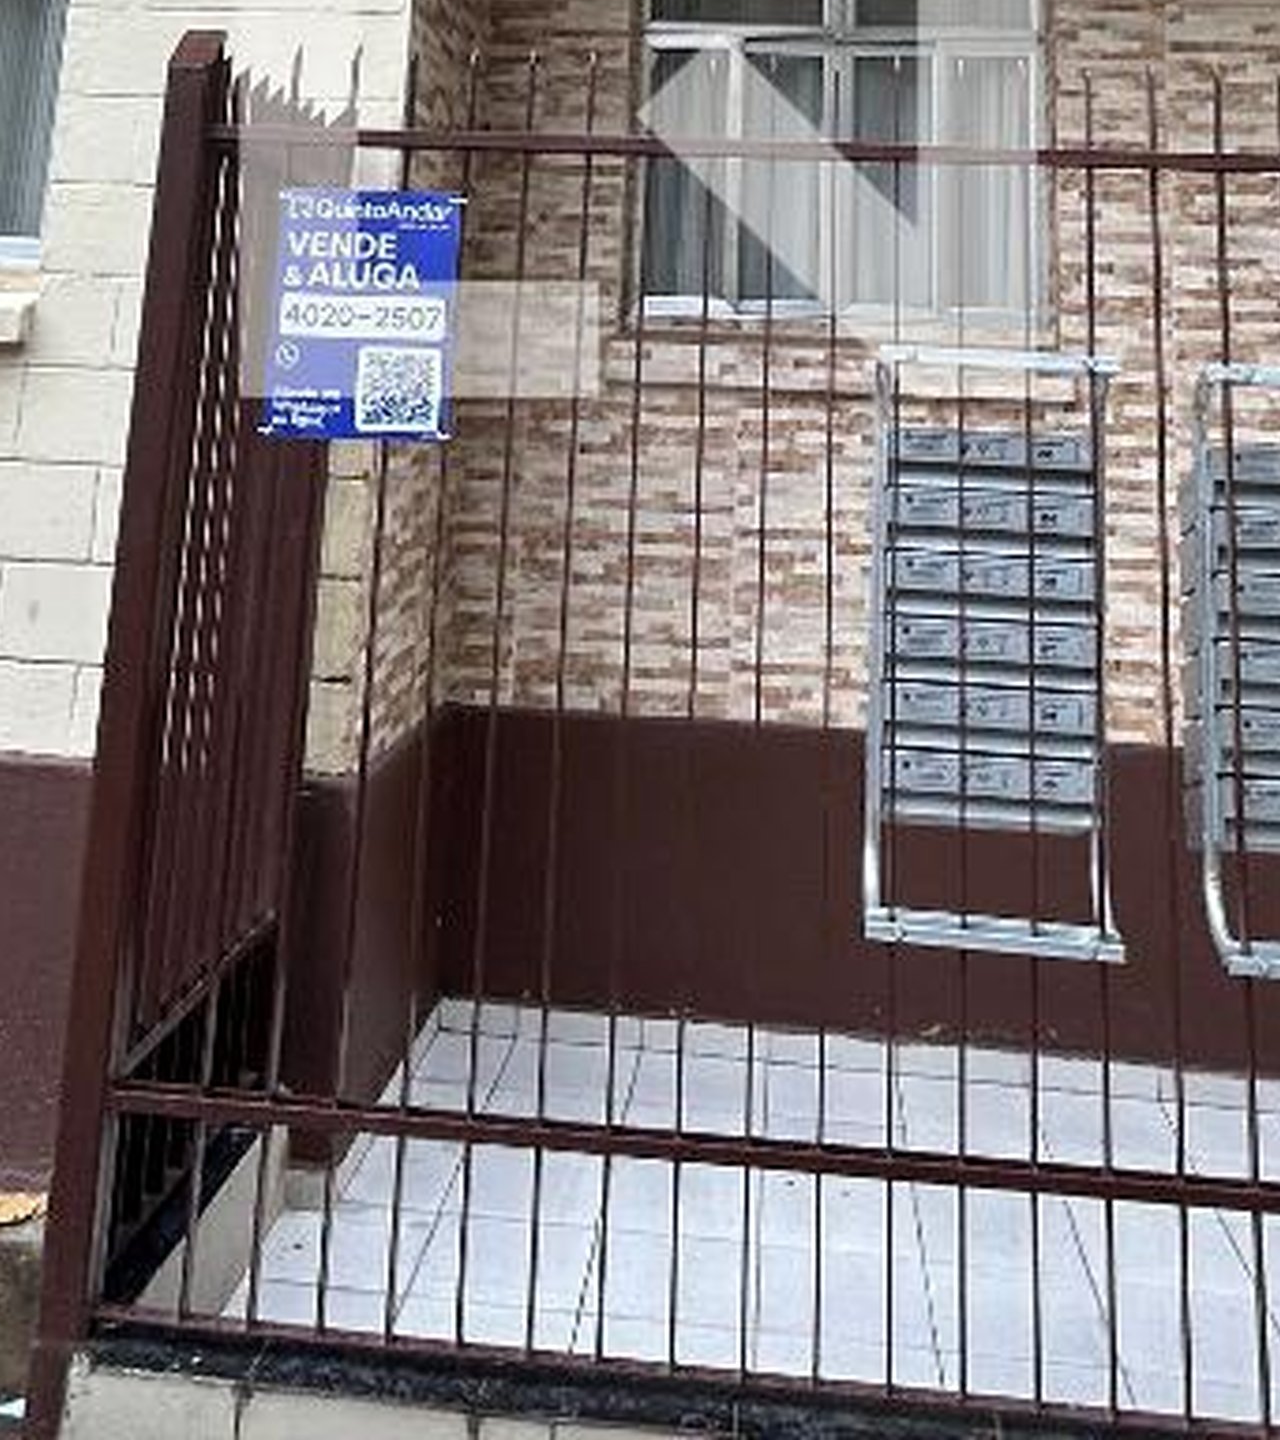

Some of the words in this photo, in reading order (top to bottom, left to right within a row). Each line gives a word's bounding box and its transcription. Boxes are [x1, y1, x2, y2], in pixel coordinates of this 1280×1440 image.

[316, 198, 453, 221] QuintoAndar
[288, 231, 398, 259] VENDE
[284, 265, 303, 286] &
[307, 263, 420, 290] ALUGA
[283, 302, 442, 330] 4020-2507
